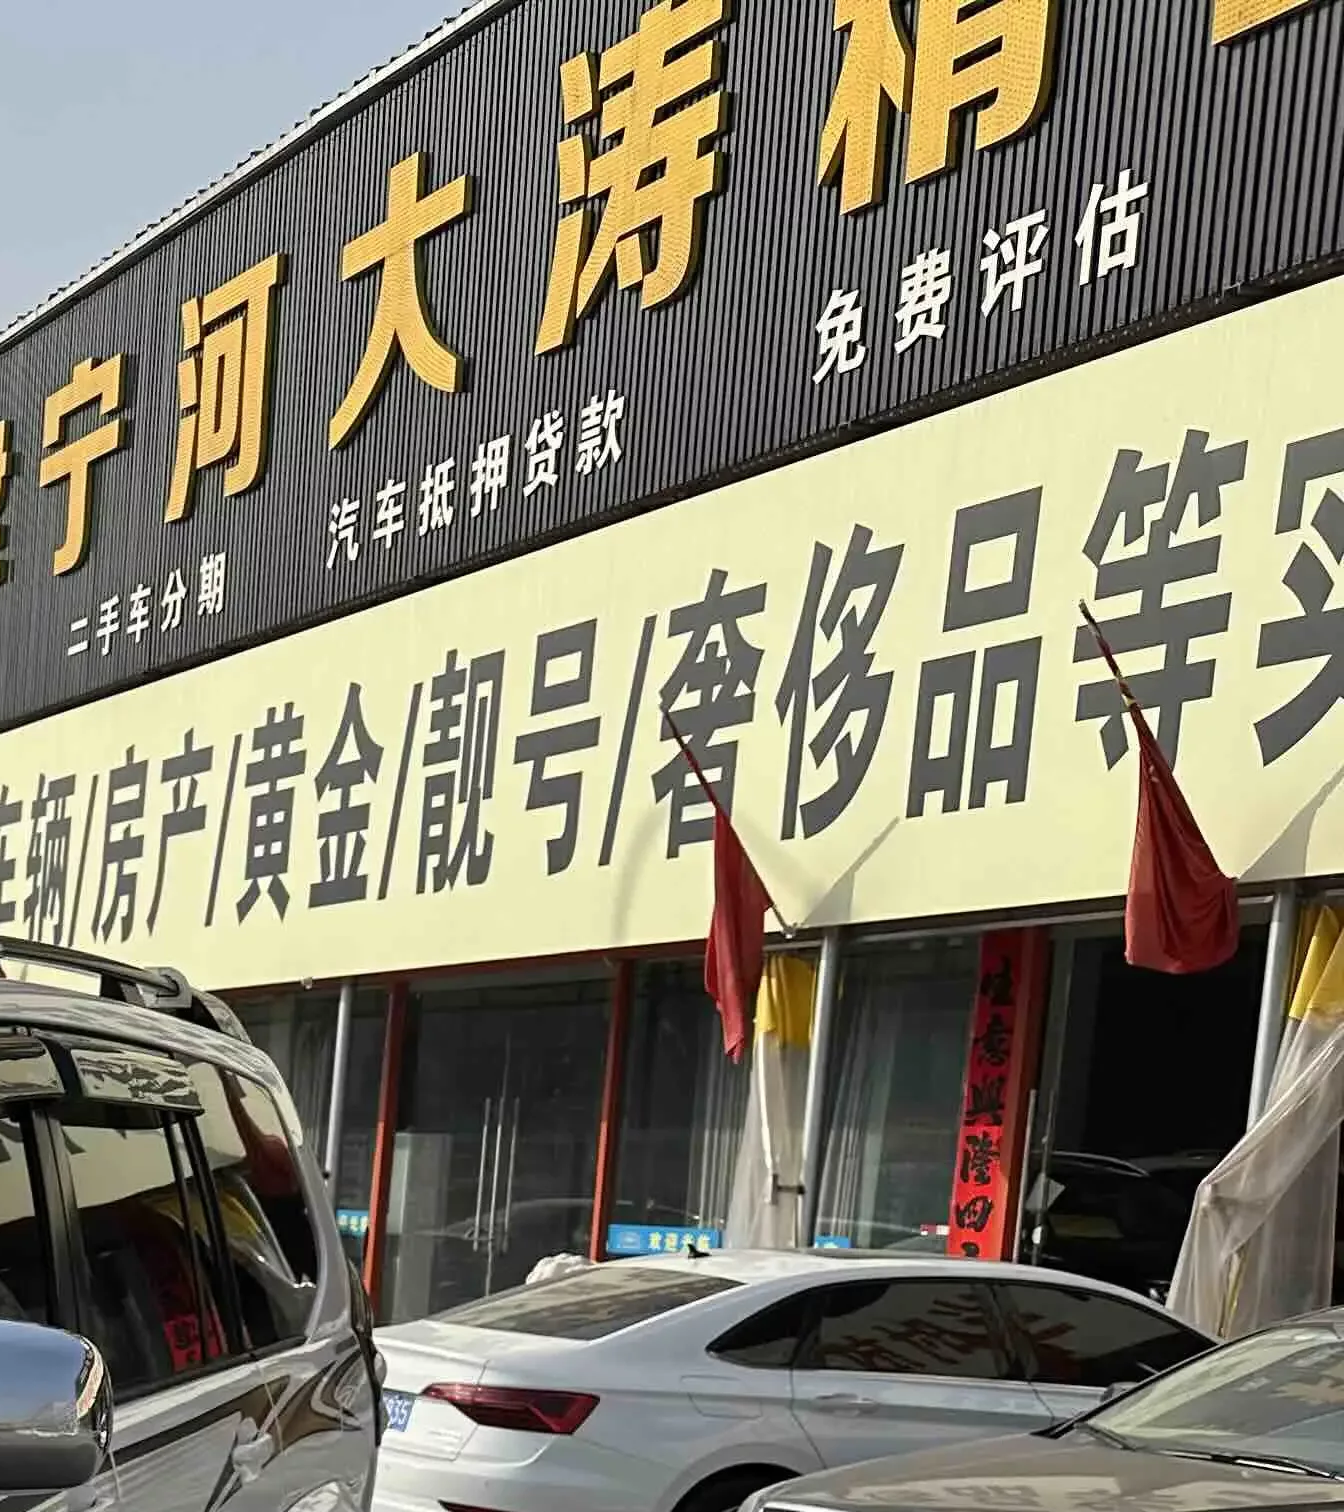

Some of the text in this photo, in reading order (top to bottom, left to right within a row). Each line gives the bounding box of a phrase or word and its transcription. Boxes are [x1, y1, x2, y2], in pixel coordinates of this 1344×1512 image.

[812, 168, 1150, 385] 免费评估
[324, 389, 627, 570] 汽车抵押贷款
[67, 551, 226, 658] 二手车分期
